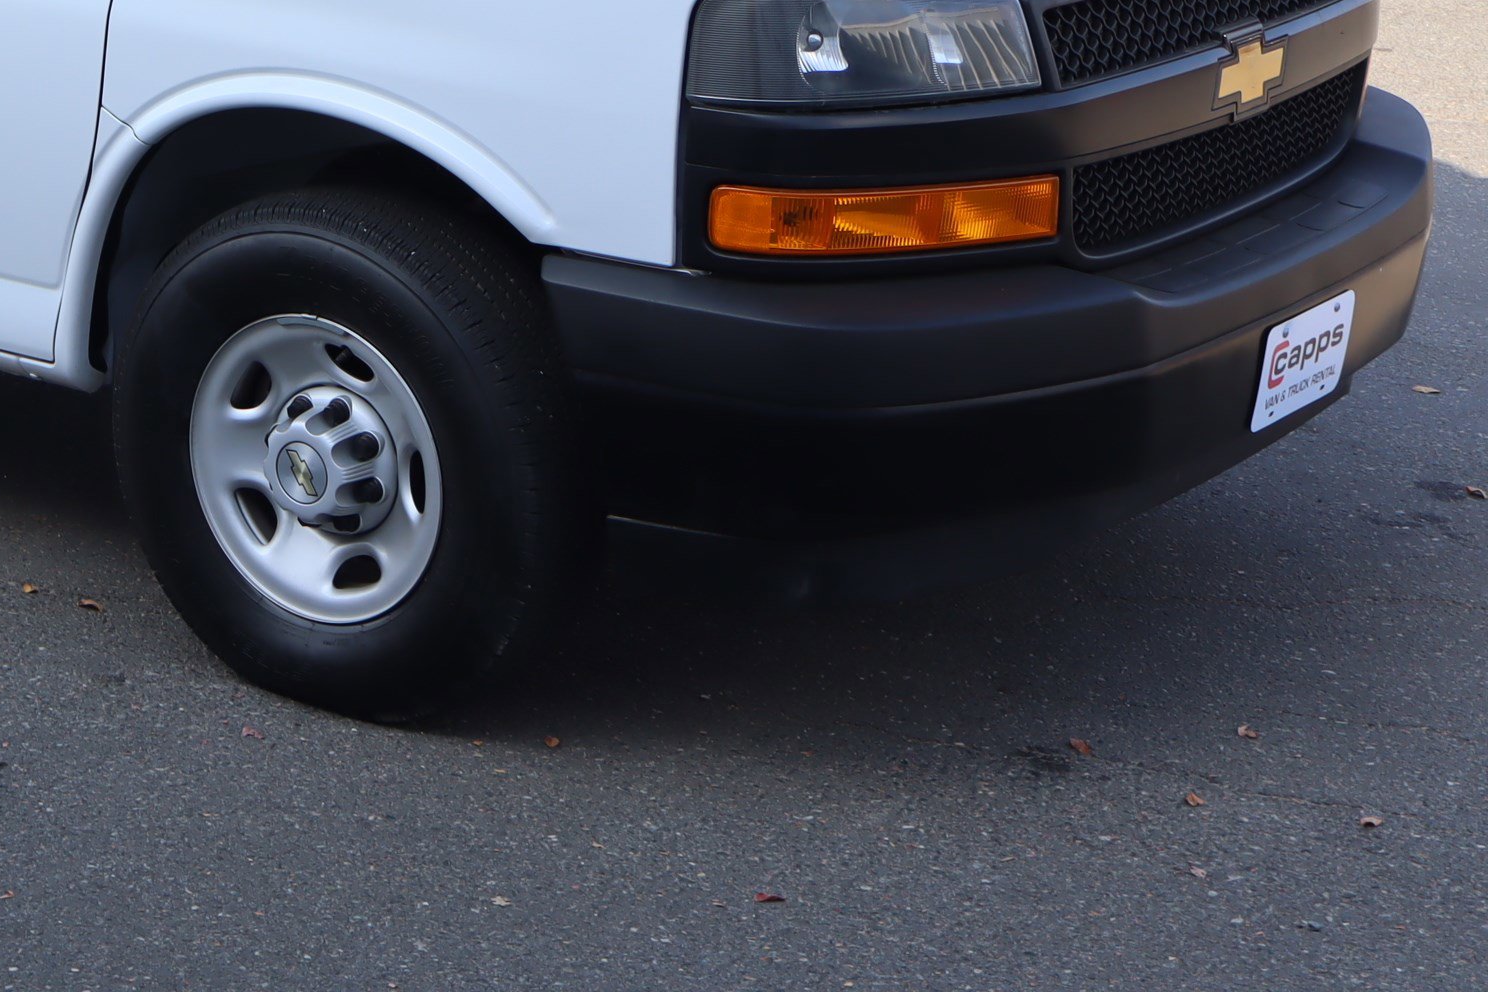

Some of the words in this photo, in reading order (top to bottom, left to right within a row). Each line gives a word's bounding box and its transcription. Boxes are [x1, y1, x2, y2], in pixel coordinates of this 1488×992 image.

[1265, 393, 1280, 410] VAN
[1288, 378, 1310, 397] TRUCK
[1310, 365, 1335, 385] RENTAL
